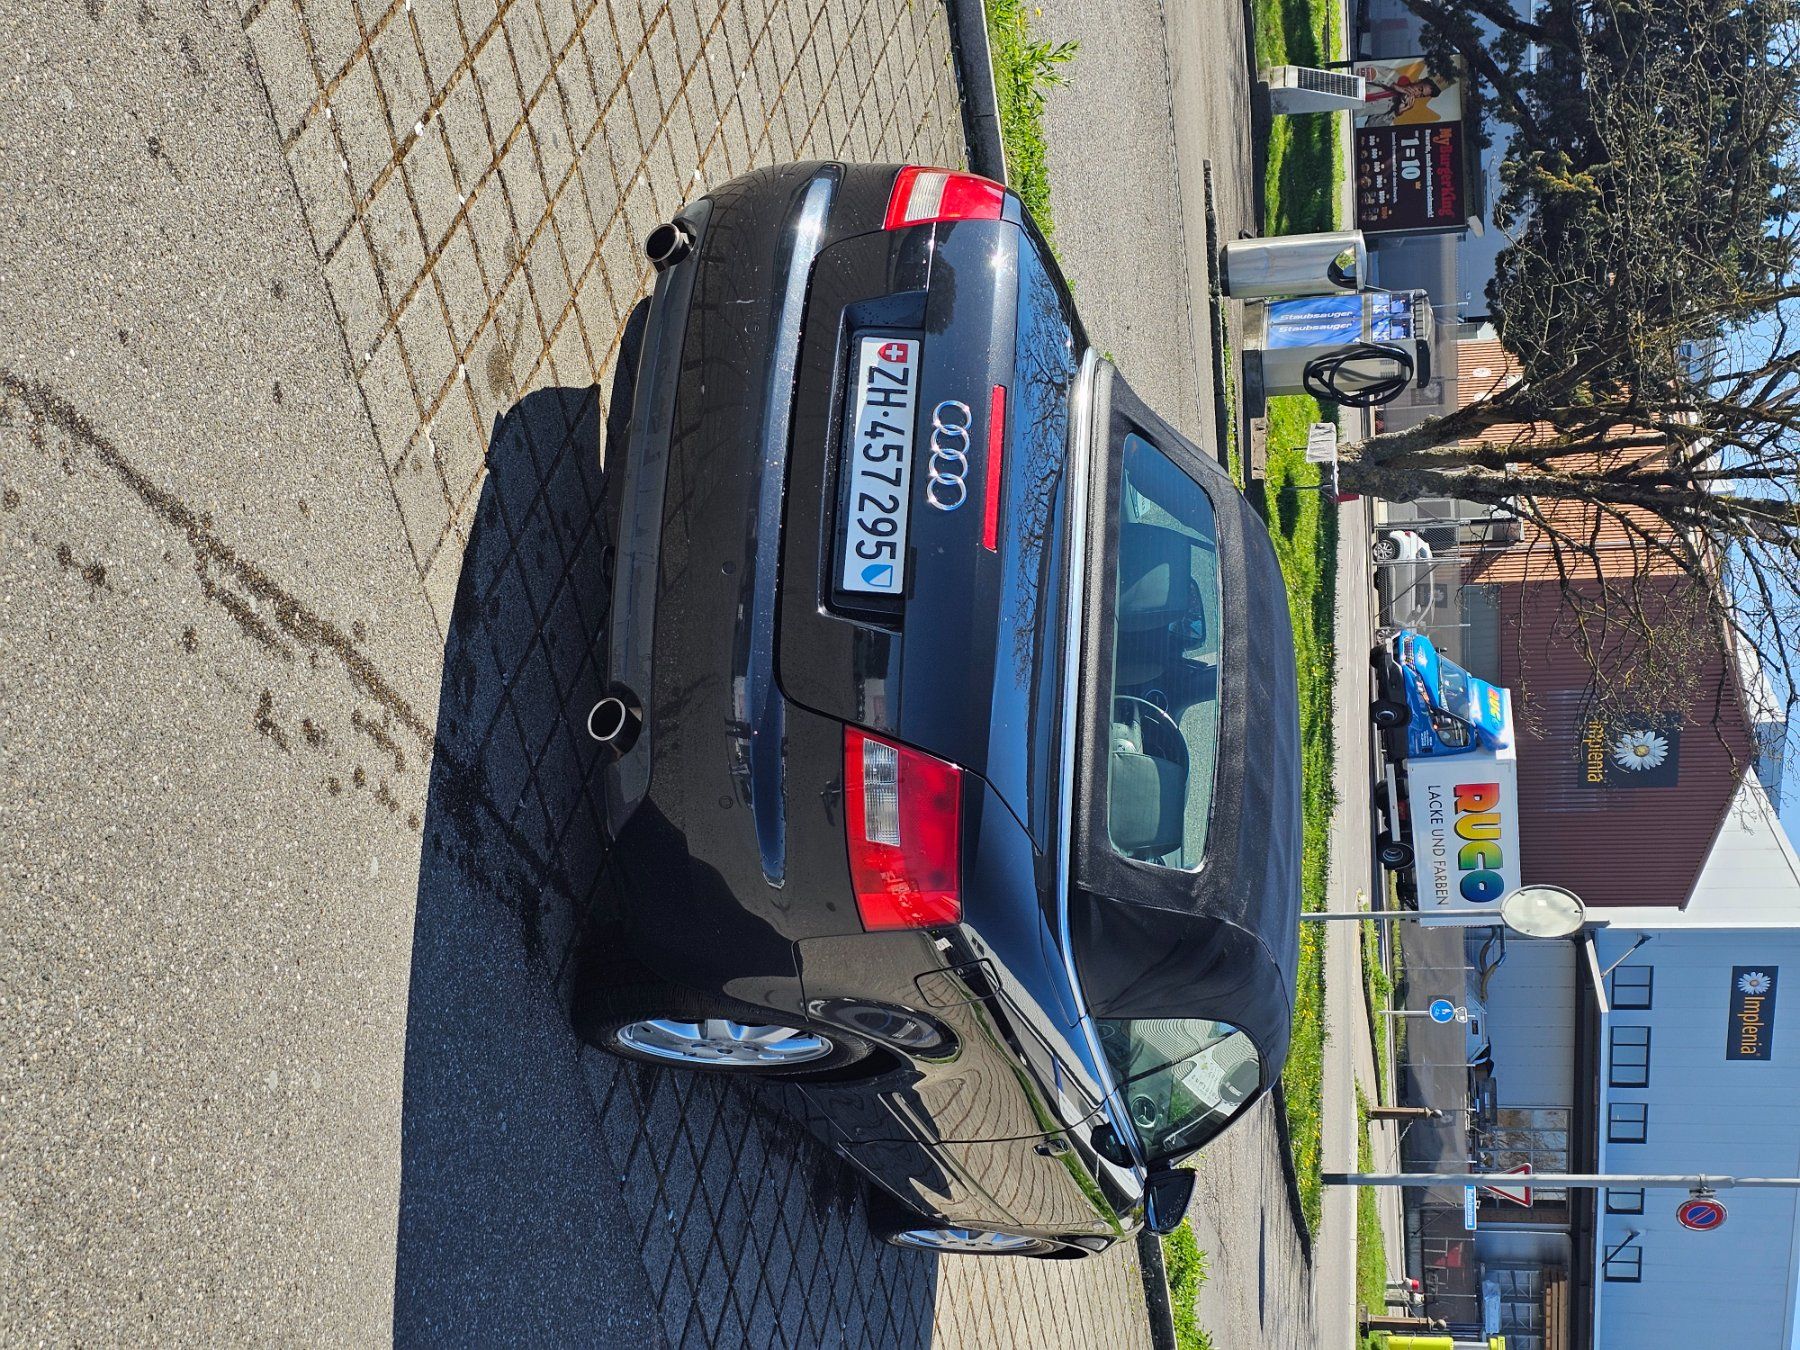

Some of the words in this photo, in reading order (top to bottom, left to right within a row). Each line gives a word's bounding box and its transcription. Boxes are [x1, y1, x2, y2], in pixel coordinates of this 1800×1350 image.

[1401, 138, 1420, 146] 1
[1401, 159, 1420, 180] 10
[1432, 128, 1455, 217] MyBurgerKing
[1279, 323, 1352, 332] Staubsauger
[1280, 311, 1353, 320] Staubsauger
[1428, 785, 1443, 824] LACKE
[1431, 829, 1446, 856] UND
[1454, 783, 1504, 902] RUCO
[1433, 860, 1448, 906] FARBEN
[1737, 996, 1766, 1054] Implenia
